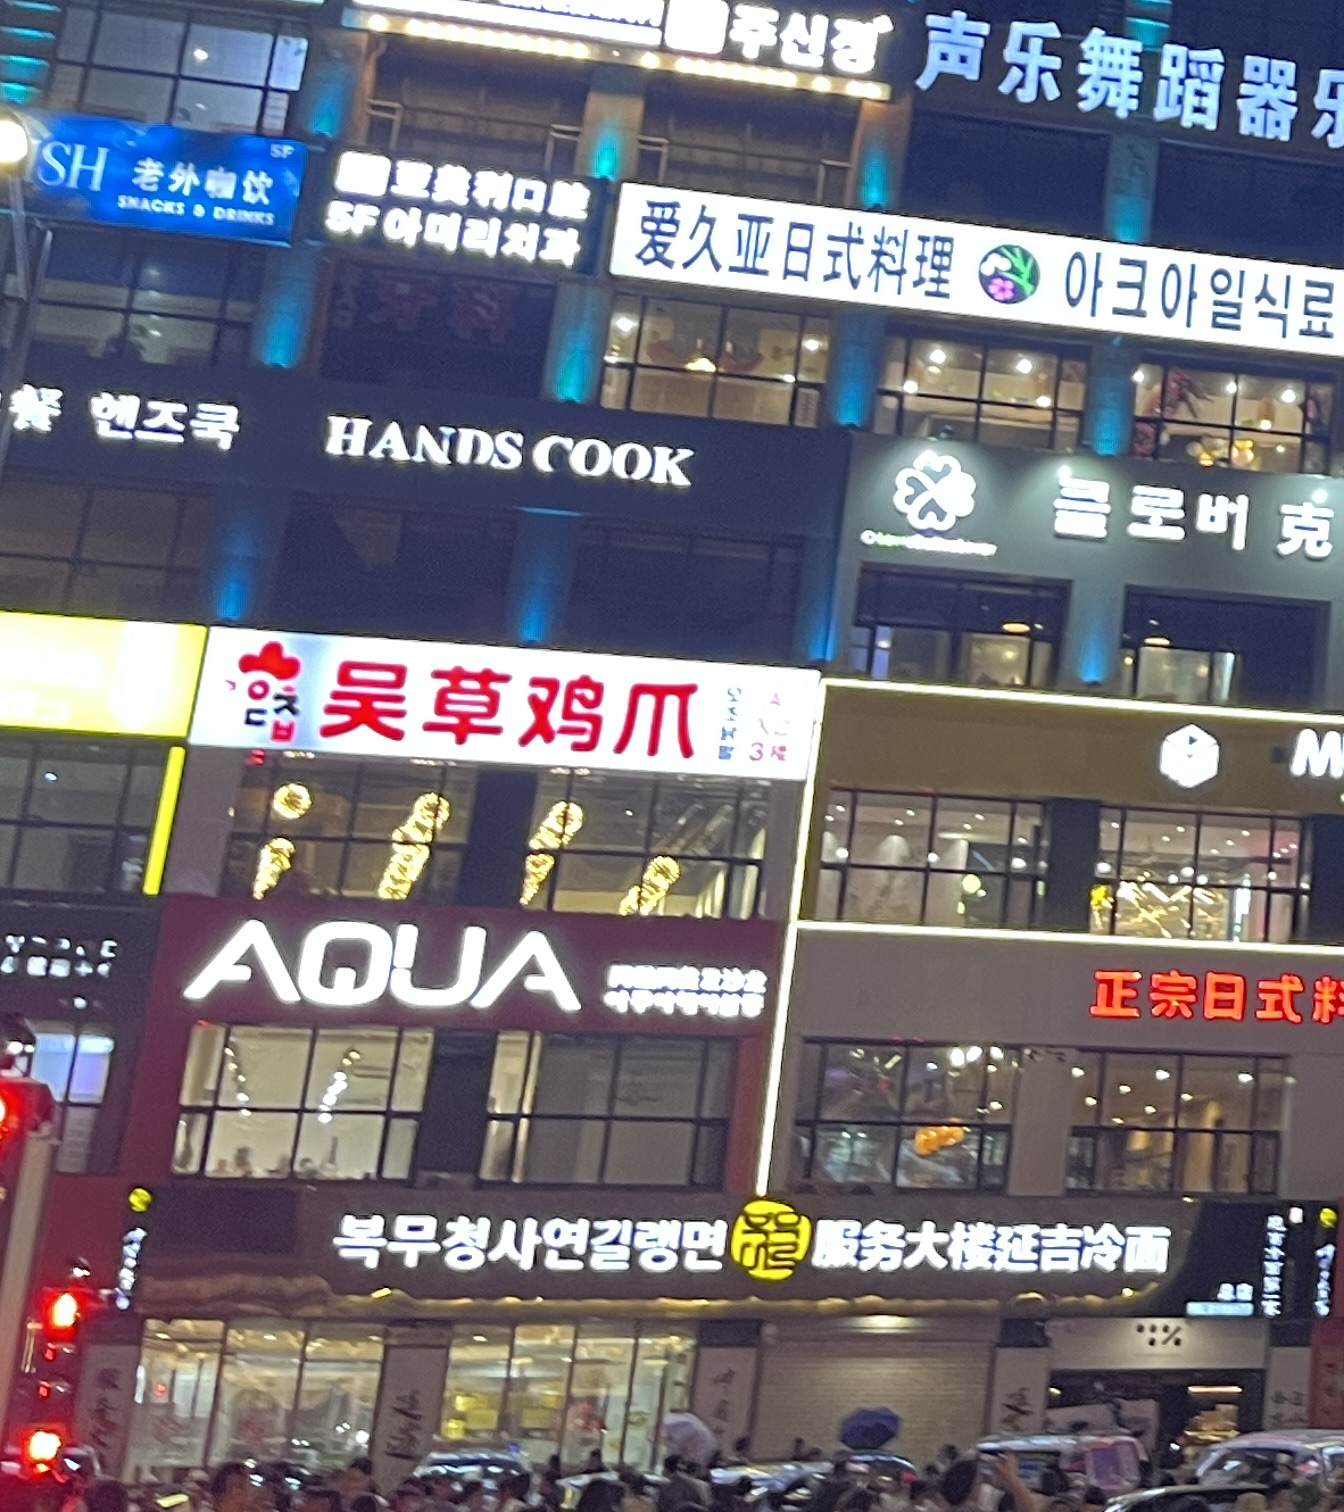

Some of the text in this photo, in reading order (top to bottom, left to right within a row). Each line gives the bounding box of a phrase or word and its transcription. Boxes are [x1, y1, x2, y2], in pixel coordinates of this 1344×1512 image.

[635, 198, 955, 301] 爱久亚日式料理
[324, 414, 695, 489] HANDS COOK
[319, 659, 700, 760] 吴草鸡爪
[183, 918, 584, 1012] AQUA
[812, 1219, 1172, 1275] 服务大楼延吉冷面
